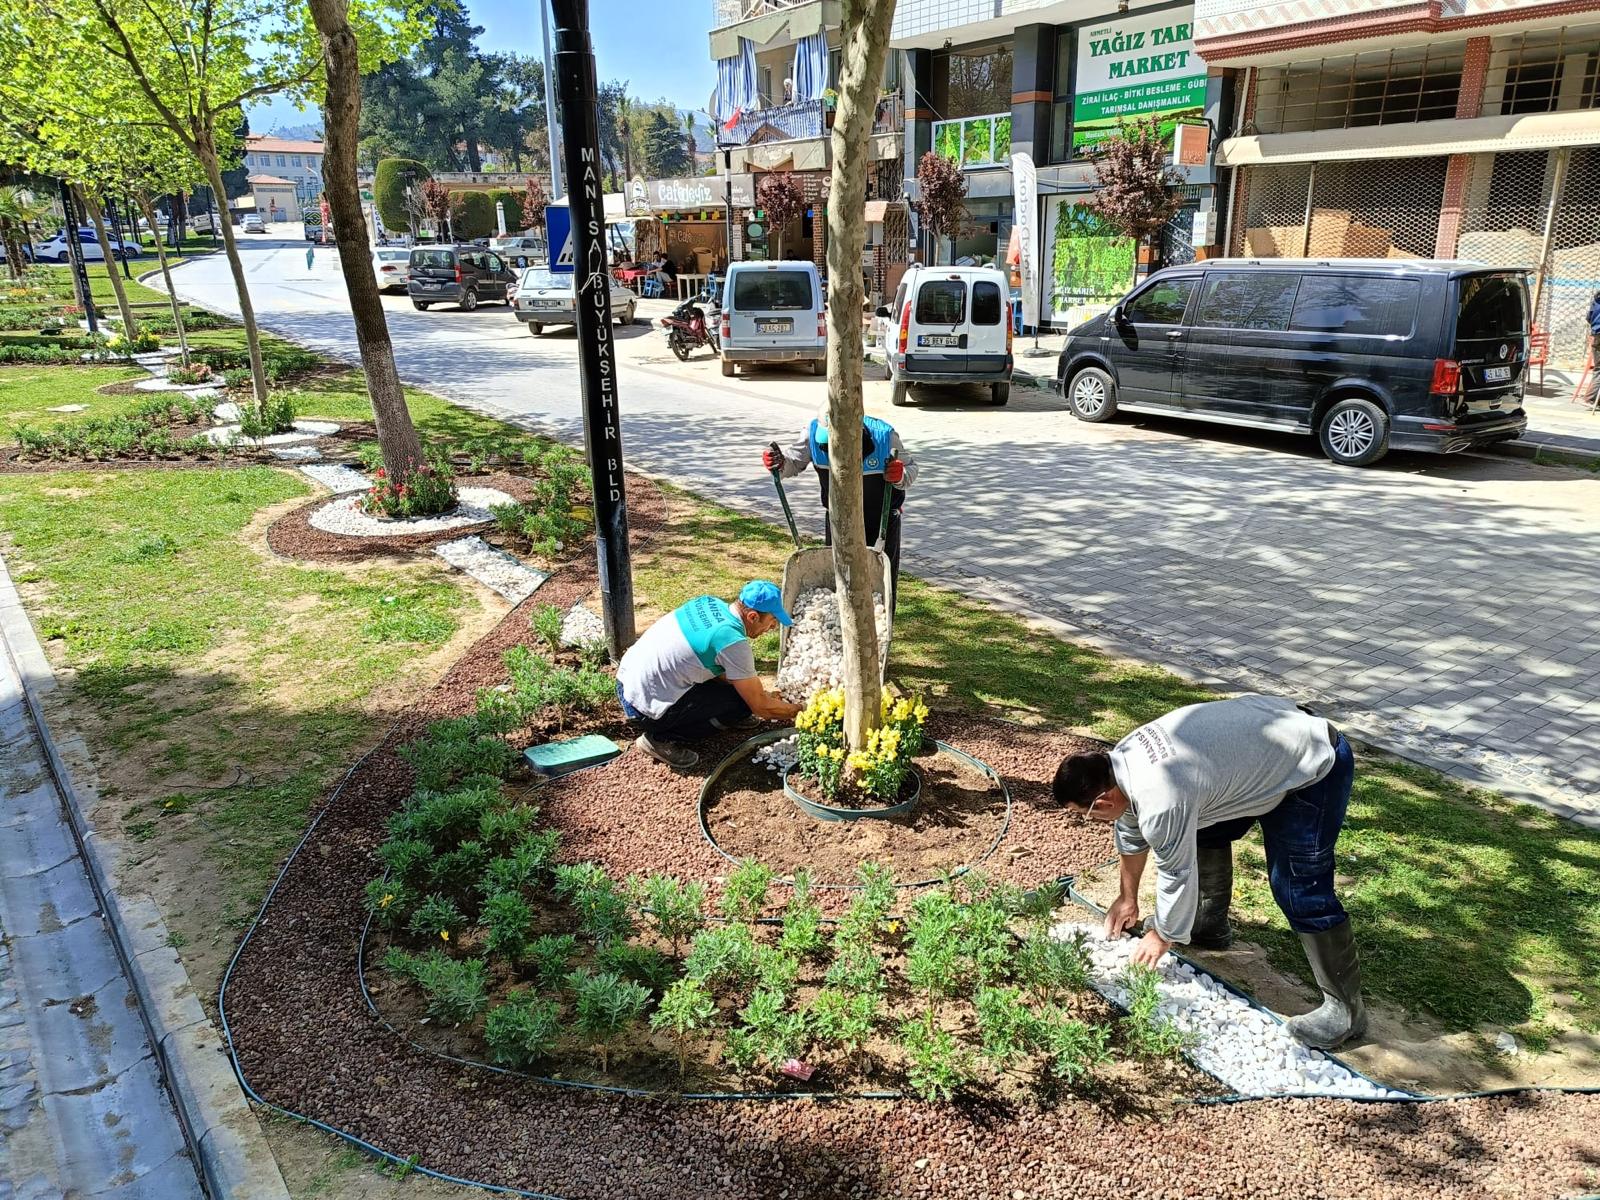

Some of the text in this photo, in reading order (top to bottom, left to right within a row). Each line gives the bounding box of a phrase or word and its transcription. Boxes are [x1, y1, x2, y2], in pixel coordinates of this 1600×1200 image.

[1089, 23, 1194, 57] YAĞIZ TARI
[1108, 50, 1190, 79] MARKET
[1101, 91, 1119, 103] İLAÇ
[1124, 89, 1145, 101] BİTKİ
[1145, 83, 1181, 96] BESLEME
[1101, 95, 1191, 115] TARIMSAL DANIŞMANLIK
[581, 147, 602, 253] MANİSA
[592, 275, 616, 440] BÜYÜKŞEHİR
[607, 458, 620, 502] BLD
[707, 596, 725, 623] ANİSA
